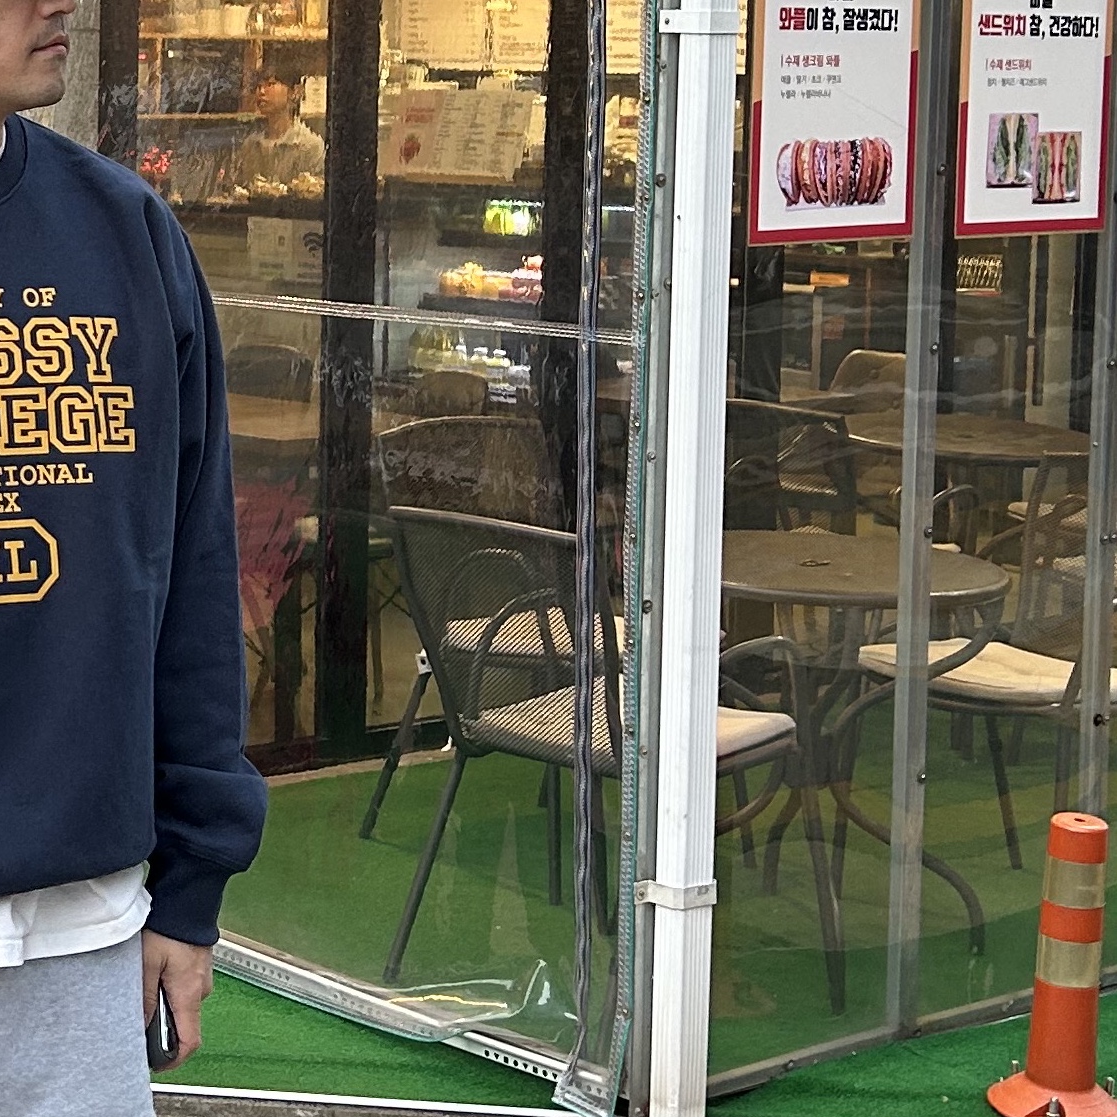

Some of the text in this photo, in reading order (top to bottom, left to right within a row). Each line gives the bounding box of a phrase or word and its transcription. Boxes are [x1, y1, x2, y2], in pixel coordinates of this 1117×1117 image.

[779, 6, 899, 34] 와플이 참, 잘생겼다!
[1029, 13, 1046, 40] 참,
[1049, 15, 1099, 38] 건강하다!
[22, 287, 57, 307] OF
